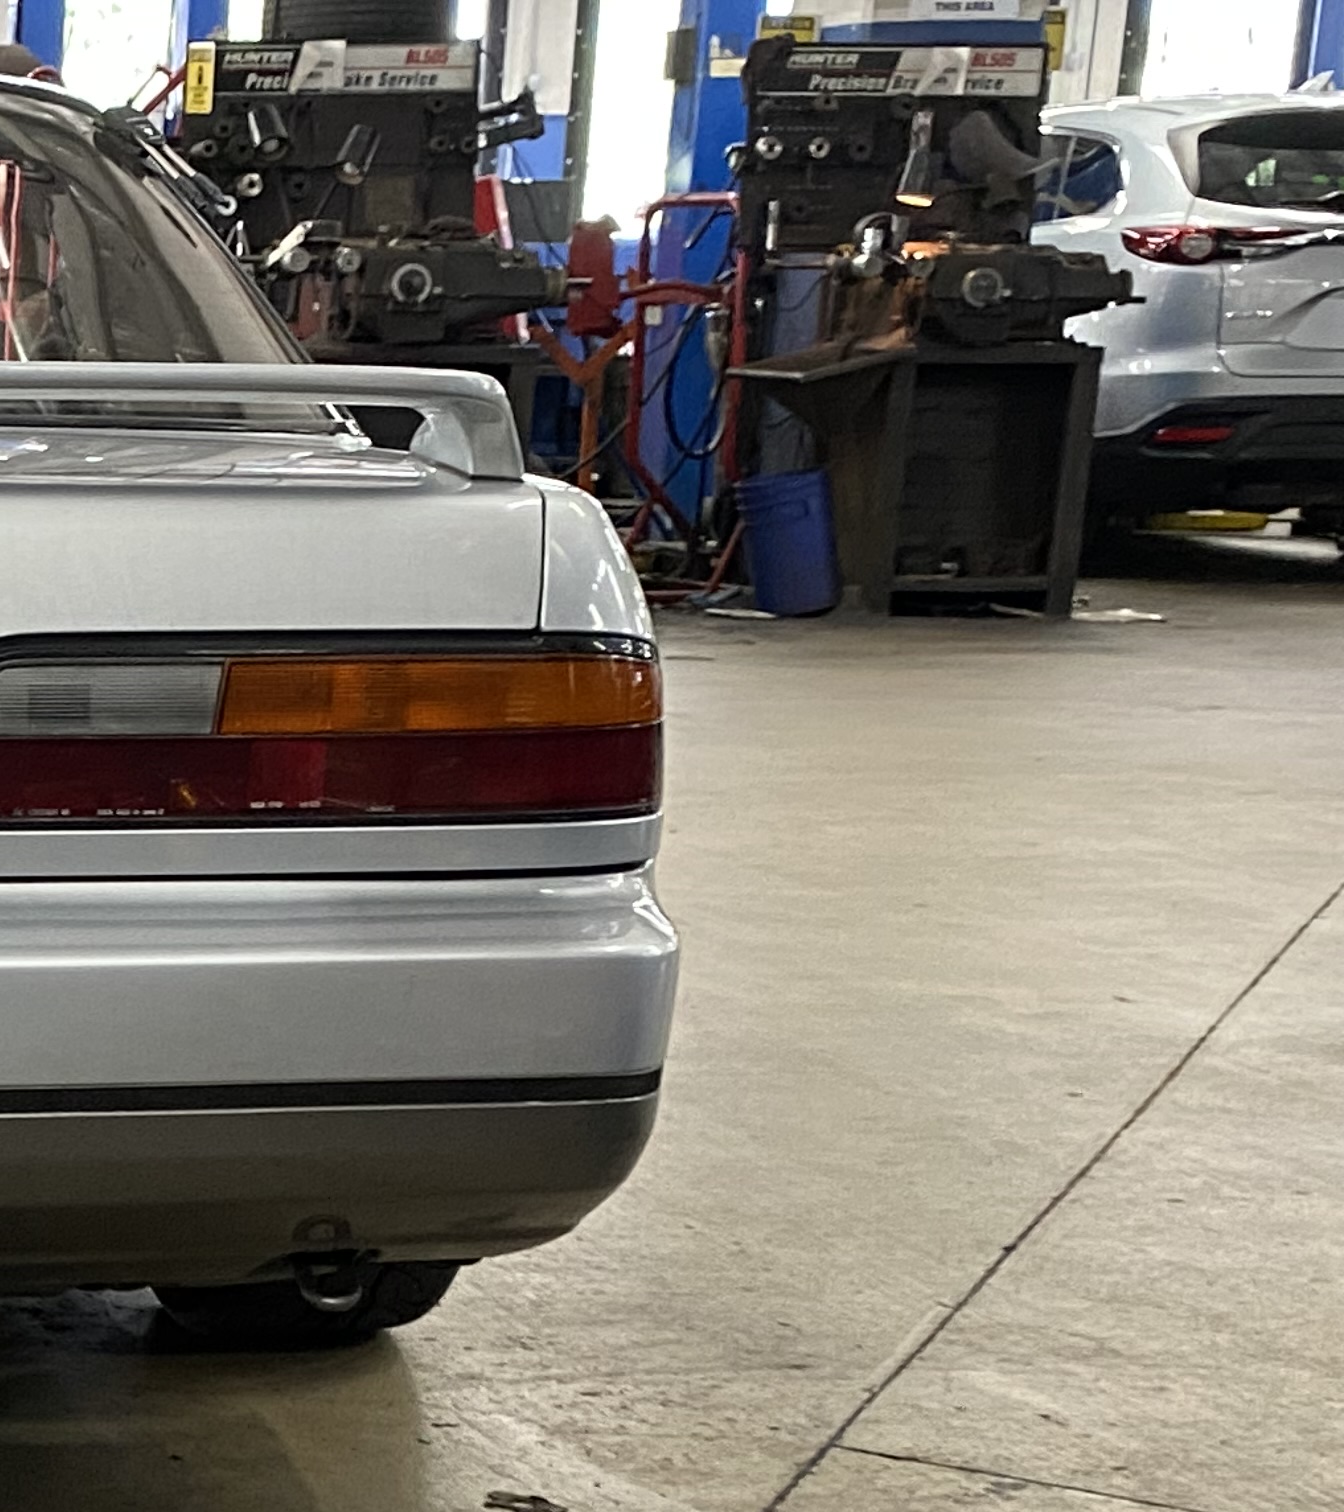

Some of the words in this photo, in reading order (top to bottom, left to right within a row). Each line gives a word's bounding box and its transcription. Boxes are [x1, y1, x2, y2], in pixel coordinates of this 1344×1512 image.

[965, 1, 995, 11] AREA
[222, 51, 294, 68] HUNTER
[787, 52, 861, 69] HUNTER
[245, 71, 290, 90] Preci
[378, 71, 438, 87] Service
[809, 73, 887, 90] Precision
